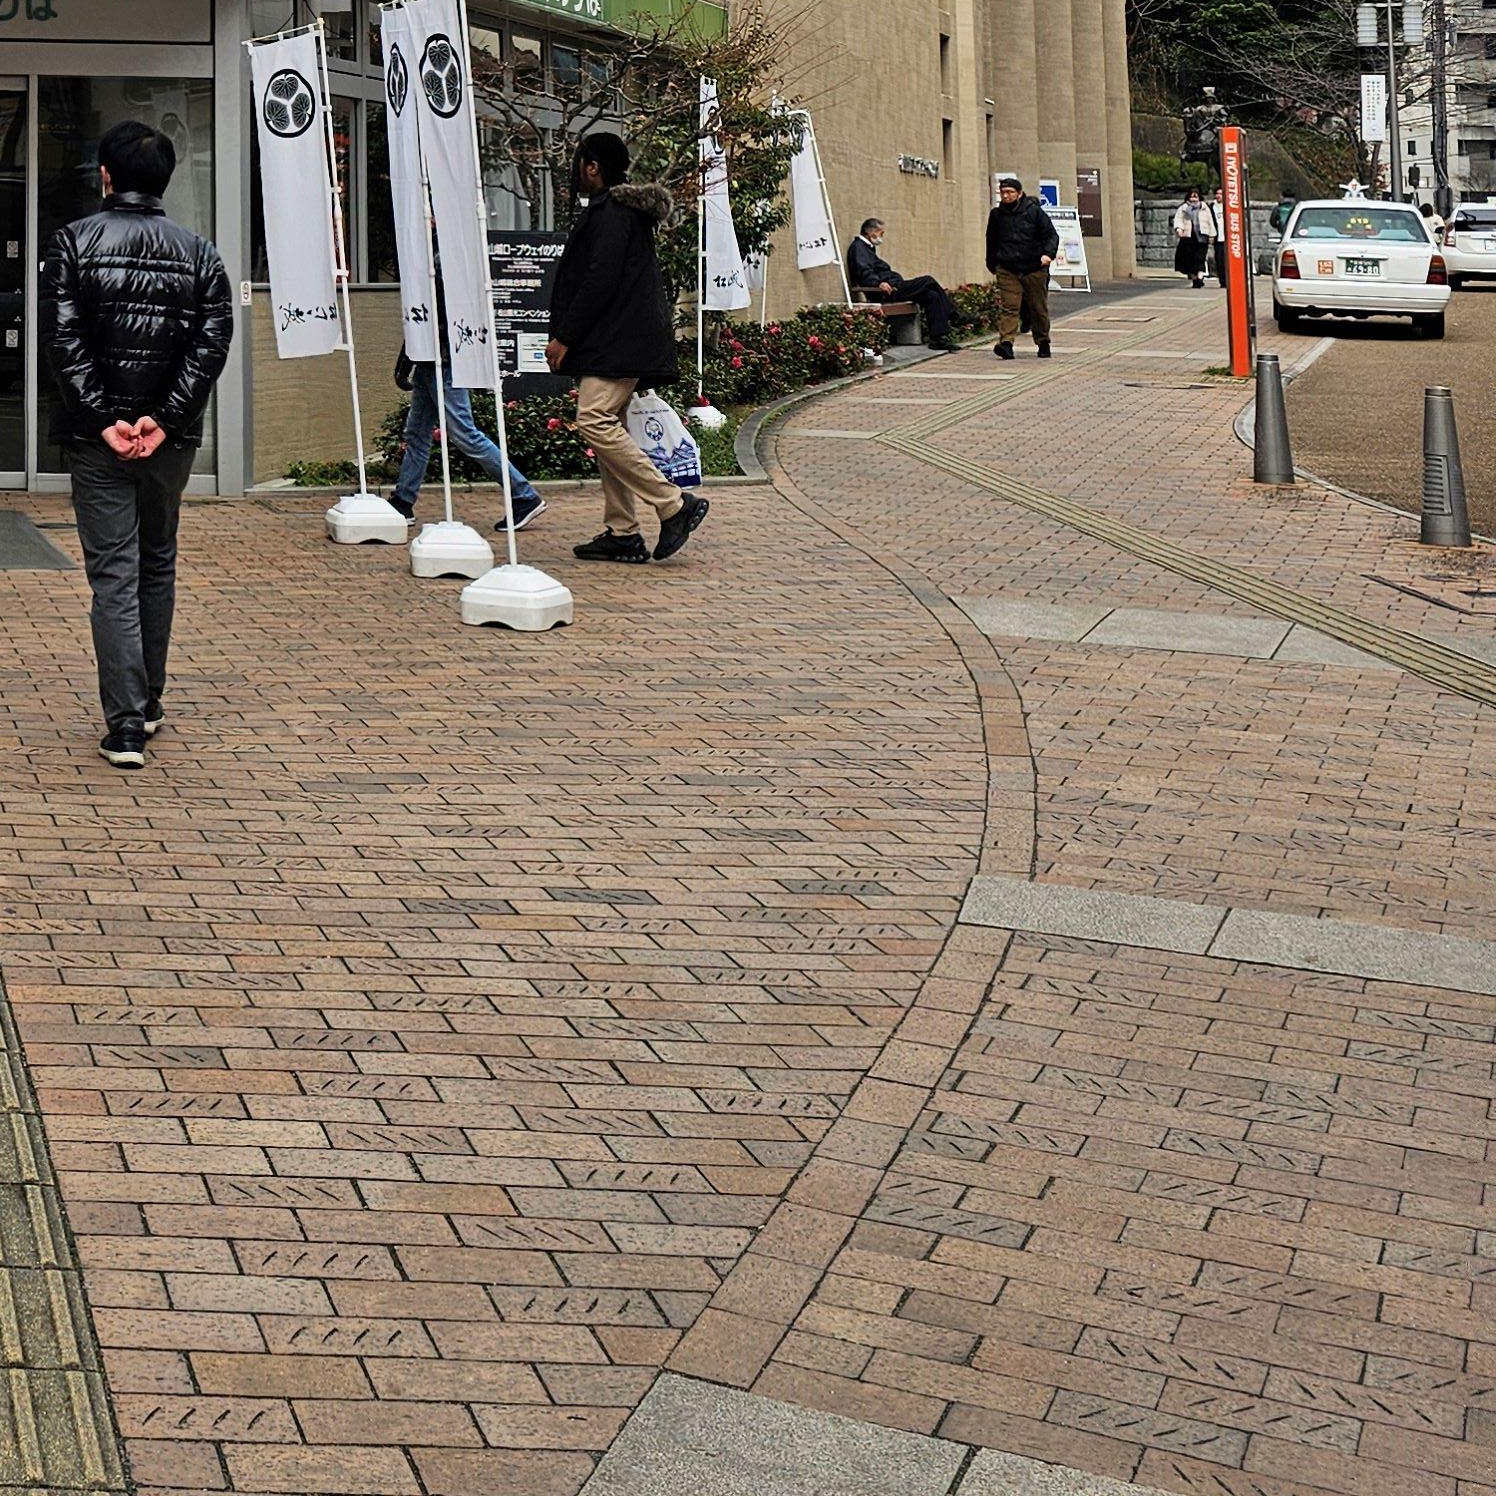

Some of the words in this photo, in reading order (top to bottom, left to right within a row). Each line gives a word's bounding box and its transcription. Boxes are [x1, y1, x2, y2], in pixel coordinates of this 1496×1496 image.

[1225, 155, 1240, 209] IYOTETSU
[1230, 212, 1240, 232] BUS
[488, 243, 565, 257] 山城ロープウェイのりば
[1231, 233, 1241, 259] STOP
